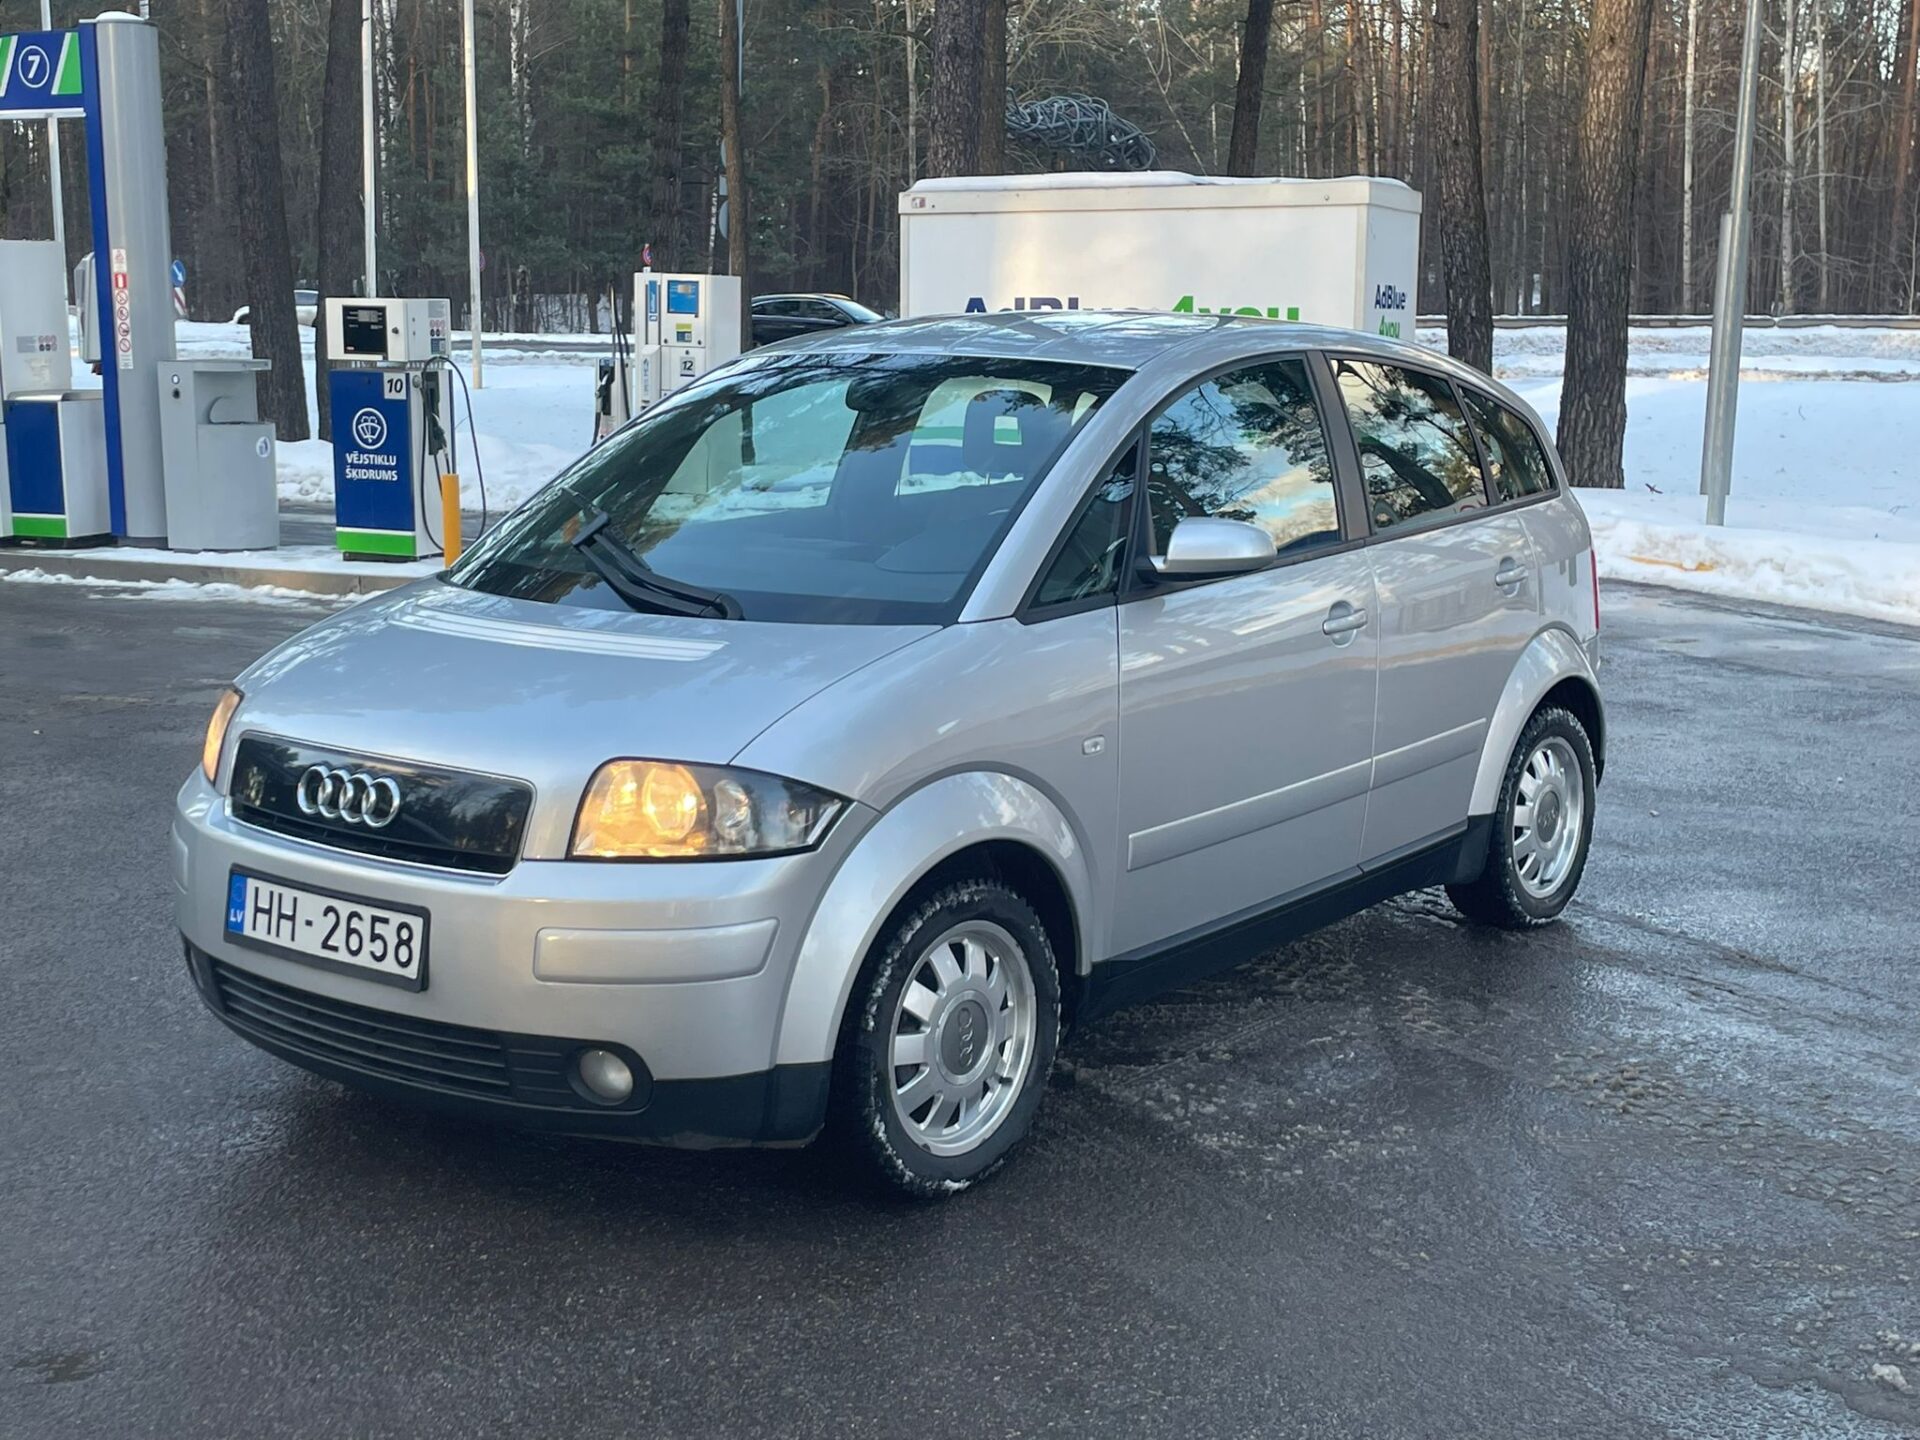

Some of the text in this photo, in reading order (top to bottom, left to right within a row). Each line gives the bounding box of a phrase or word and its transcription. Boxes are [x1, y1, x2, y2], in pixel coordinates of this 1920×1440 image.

[28, 55, 41, 79] 7
[1374, 284, 1406, 310] AdBlue
[682, 360, 694, 371] 12
[387, 378, 404, 393] 10
[345, 451, 397, 466] VĒJSTIKLU
[345, 465, 398, 481] ŠĶIDRUMS
[229, 908, 244, 923] LV
[252, 886, 414, 969] HH-2658
